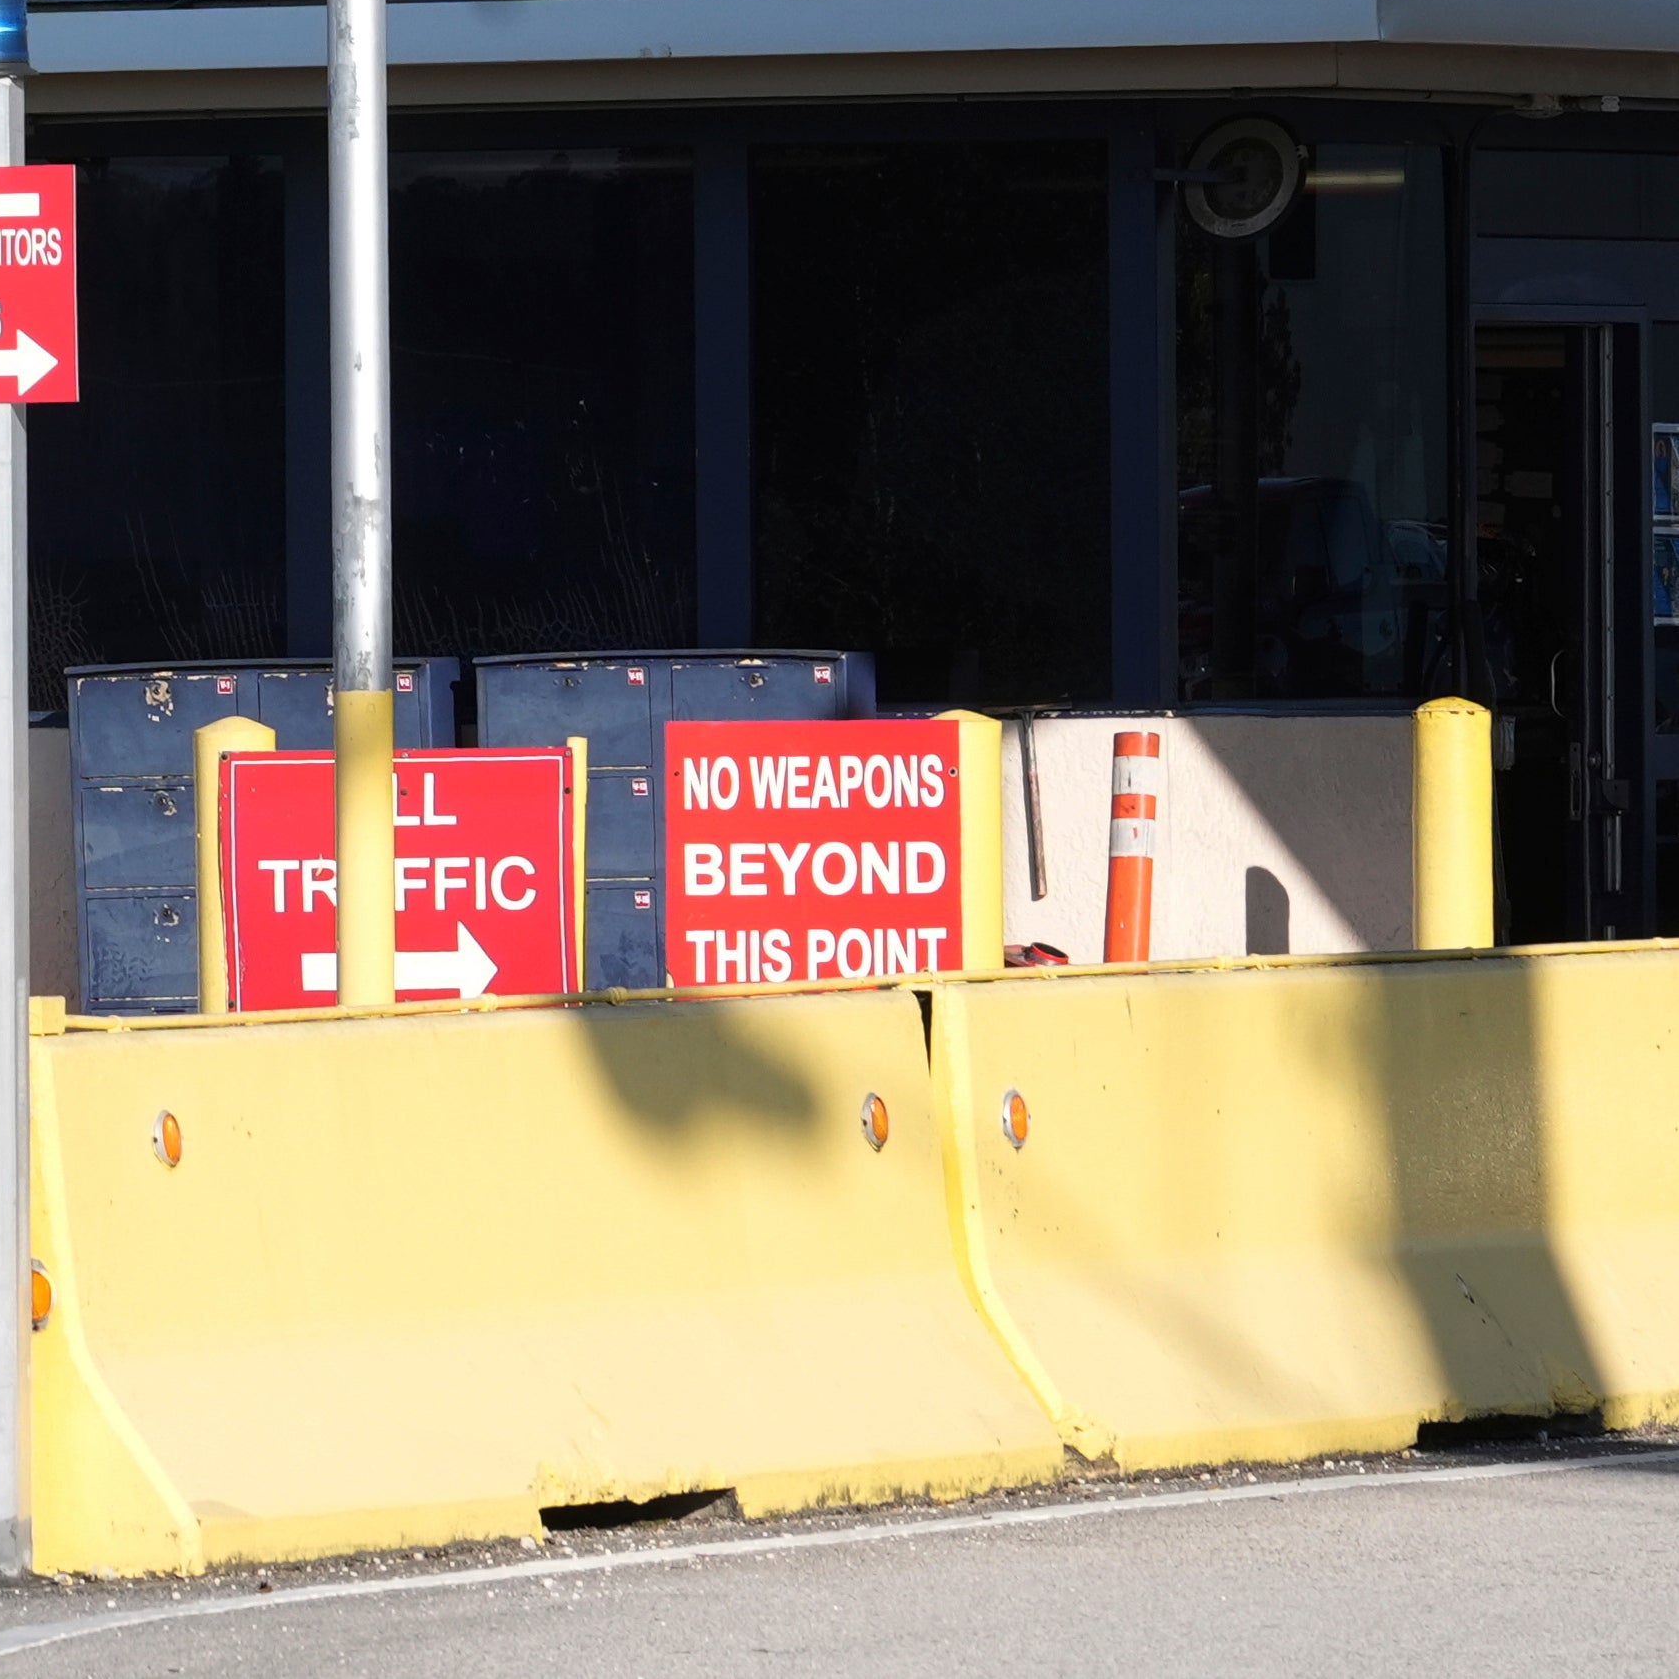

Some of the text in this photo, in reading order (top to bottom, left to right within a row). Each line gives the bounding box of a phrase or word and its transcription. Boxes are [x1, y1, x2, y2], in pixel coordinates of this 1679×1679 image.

[392, 772, 458, 827] LL
[683, 753, 946, 811] NO WEAPONS
[257, 855, 538, 913] TRFFIC
[683, 840, 947, 898] BEYOND
[685, 926, 948, 984] THIS POINT
